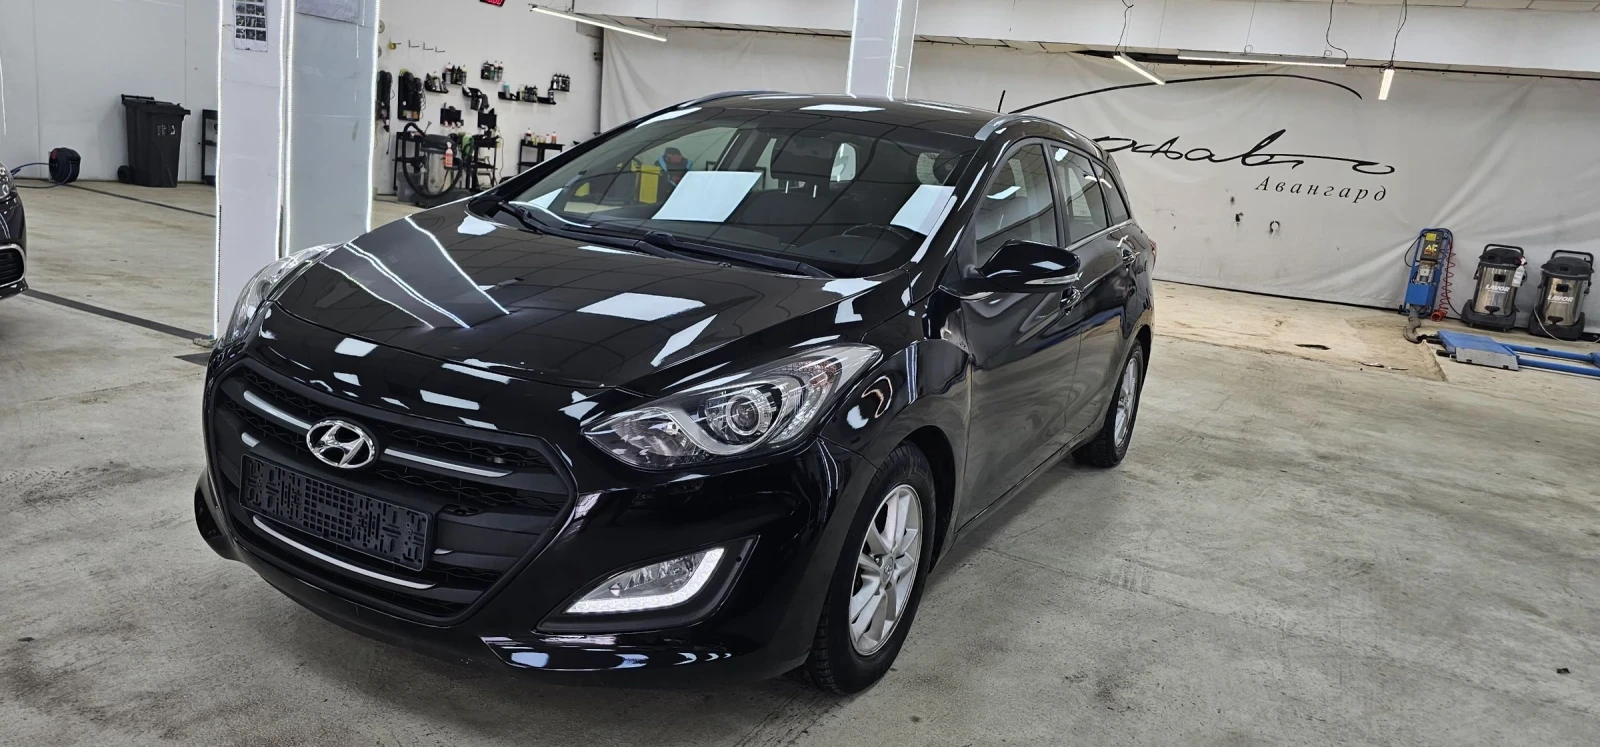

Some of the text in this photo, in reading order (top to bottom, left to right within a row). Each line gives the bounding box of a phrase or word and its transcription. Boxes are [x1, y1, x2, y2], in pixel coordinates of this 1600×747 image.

[1255, 176, 1387, 203] Авангард
[1485, 284, 1510, 292] LAVOR
[1547, 295, 1574, 303] LAVOR
